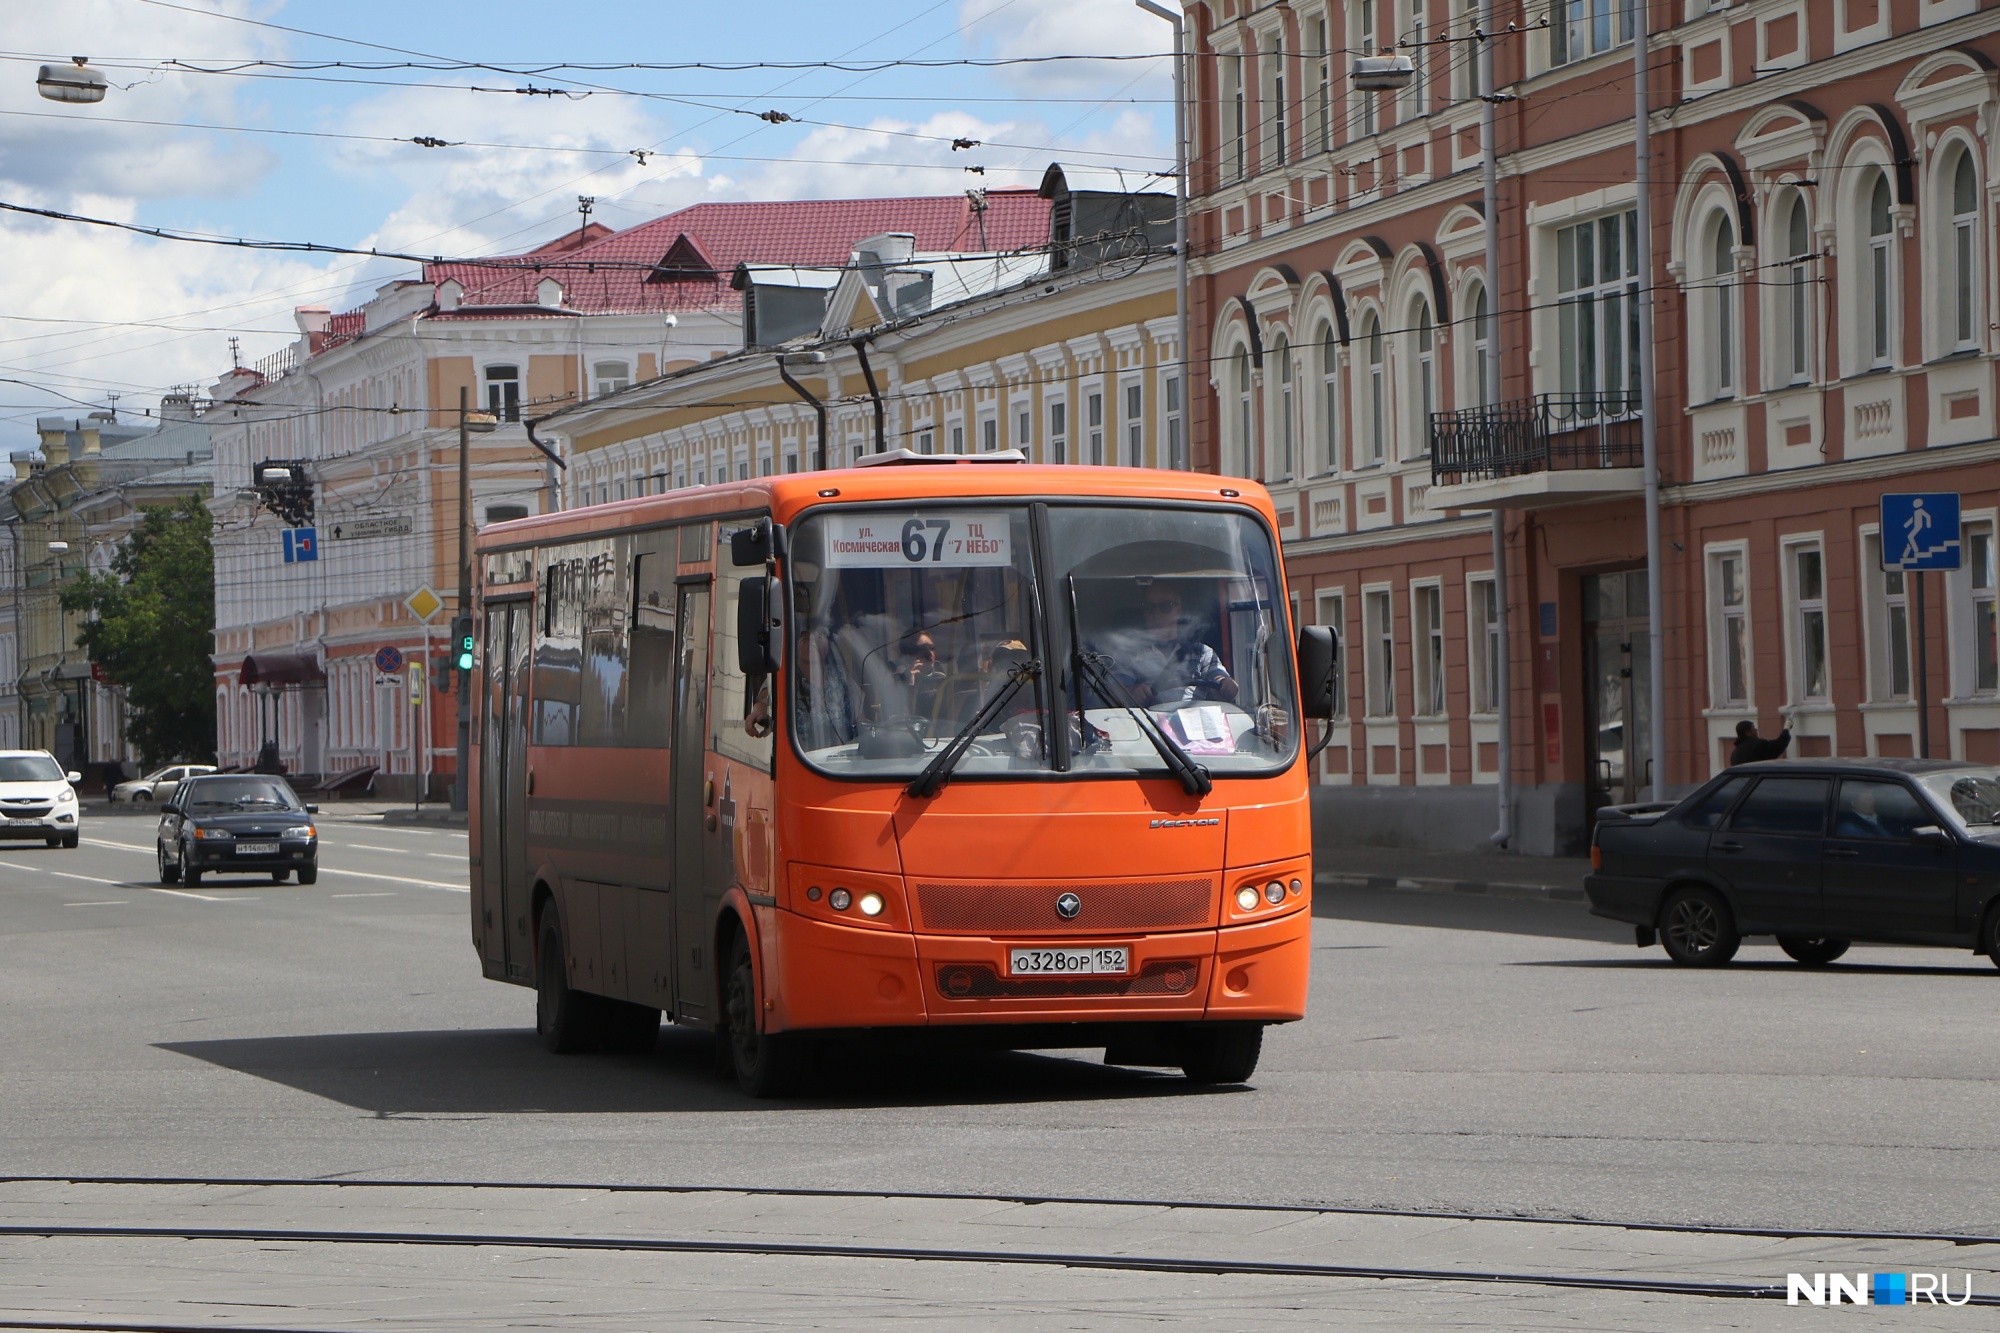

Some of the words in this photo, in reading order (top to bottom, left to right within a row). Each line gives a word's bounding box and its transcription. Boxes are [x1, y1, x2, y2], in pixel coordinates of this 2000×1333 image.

[354, 519, 398, 530] ОБЛАСТНОЕ
[385, 524, 410, 534] ГИБДД
[967, 523, 984, 539] ТЦ
[859, 527, 873, 539] ул.
[833, 540, 900, 553] Космическая
[902, 519, 950, 562] 67
[1095, 950, 1122, 965] 152
